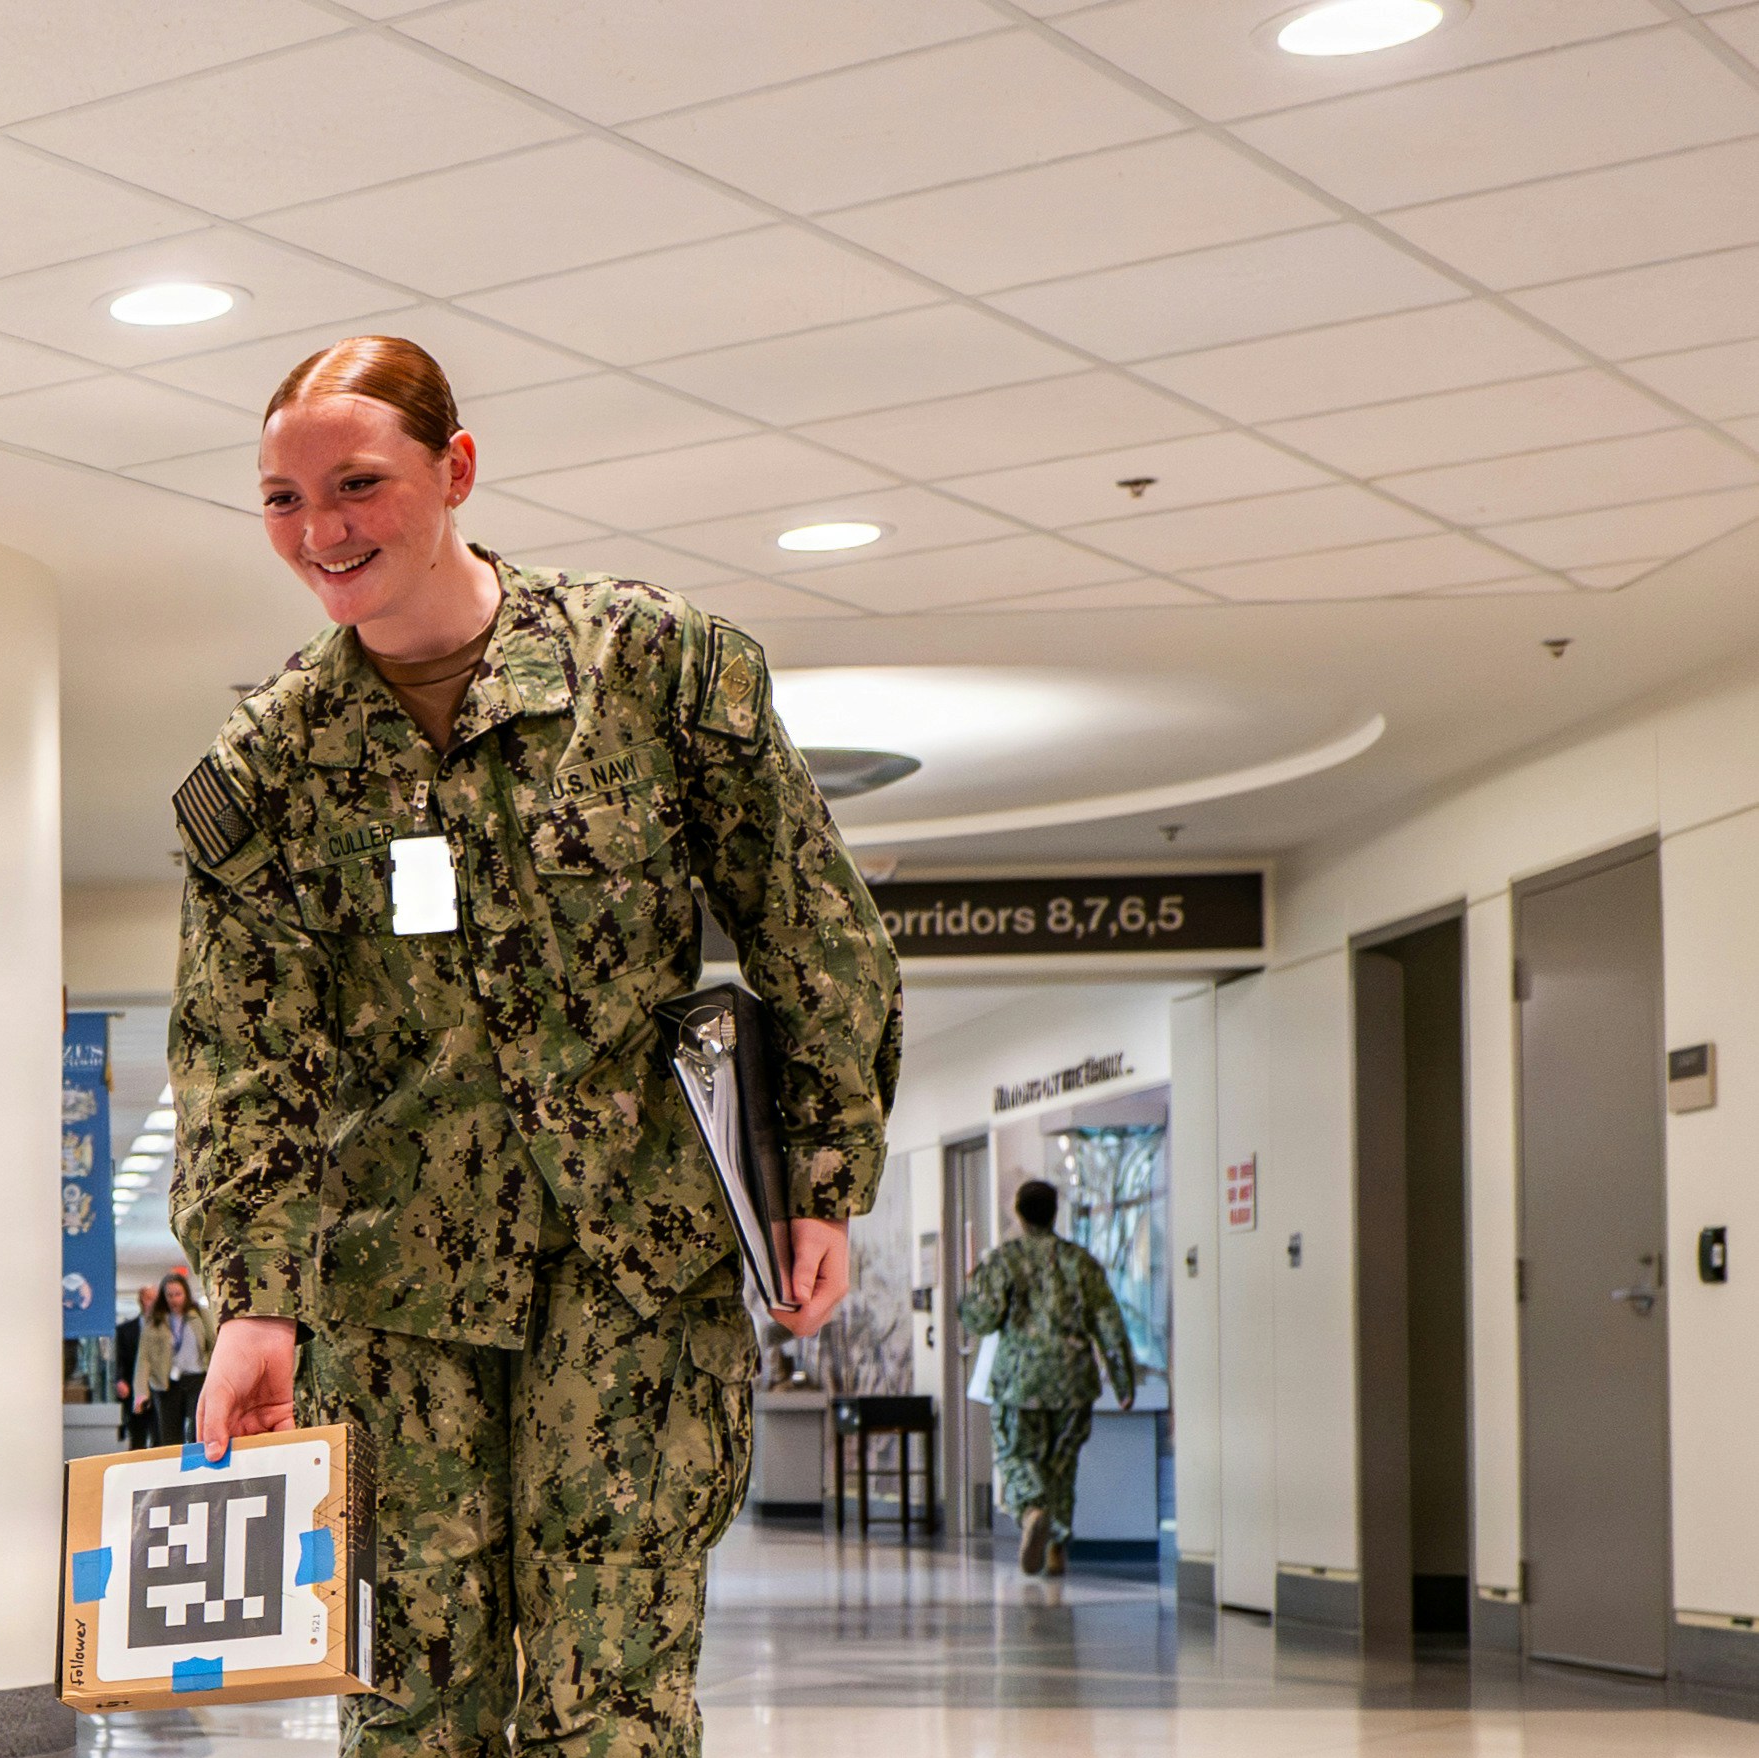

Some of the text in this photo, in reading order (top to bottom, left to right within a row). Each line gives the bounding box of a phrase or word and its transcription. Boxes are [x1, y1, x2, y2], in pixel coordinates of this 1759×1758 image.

[549, 754, 638, 800] U.S. NAVY
[329, 824, 395, 858] CULLER
[881, 896, 1184, 939] orridors 8,7,6,5
